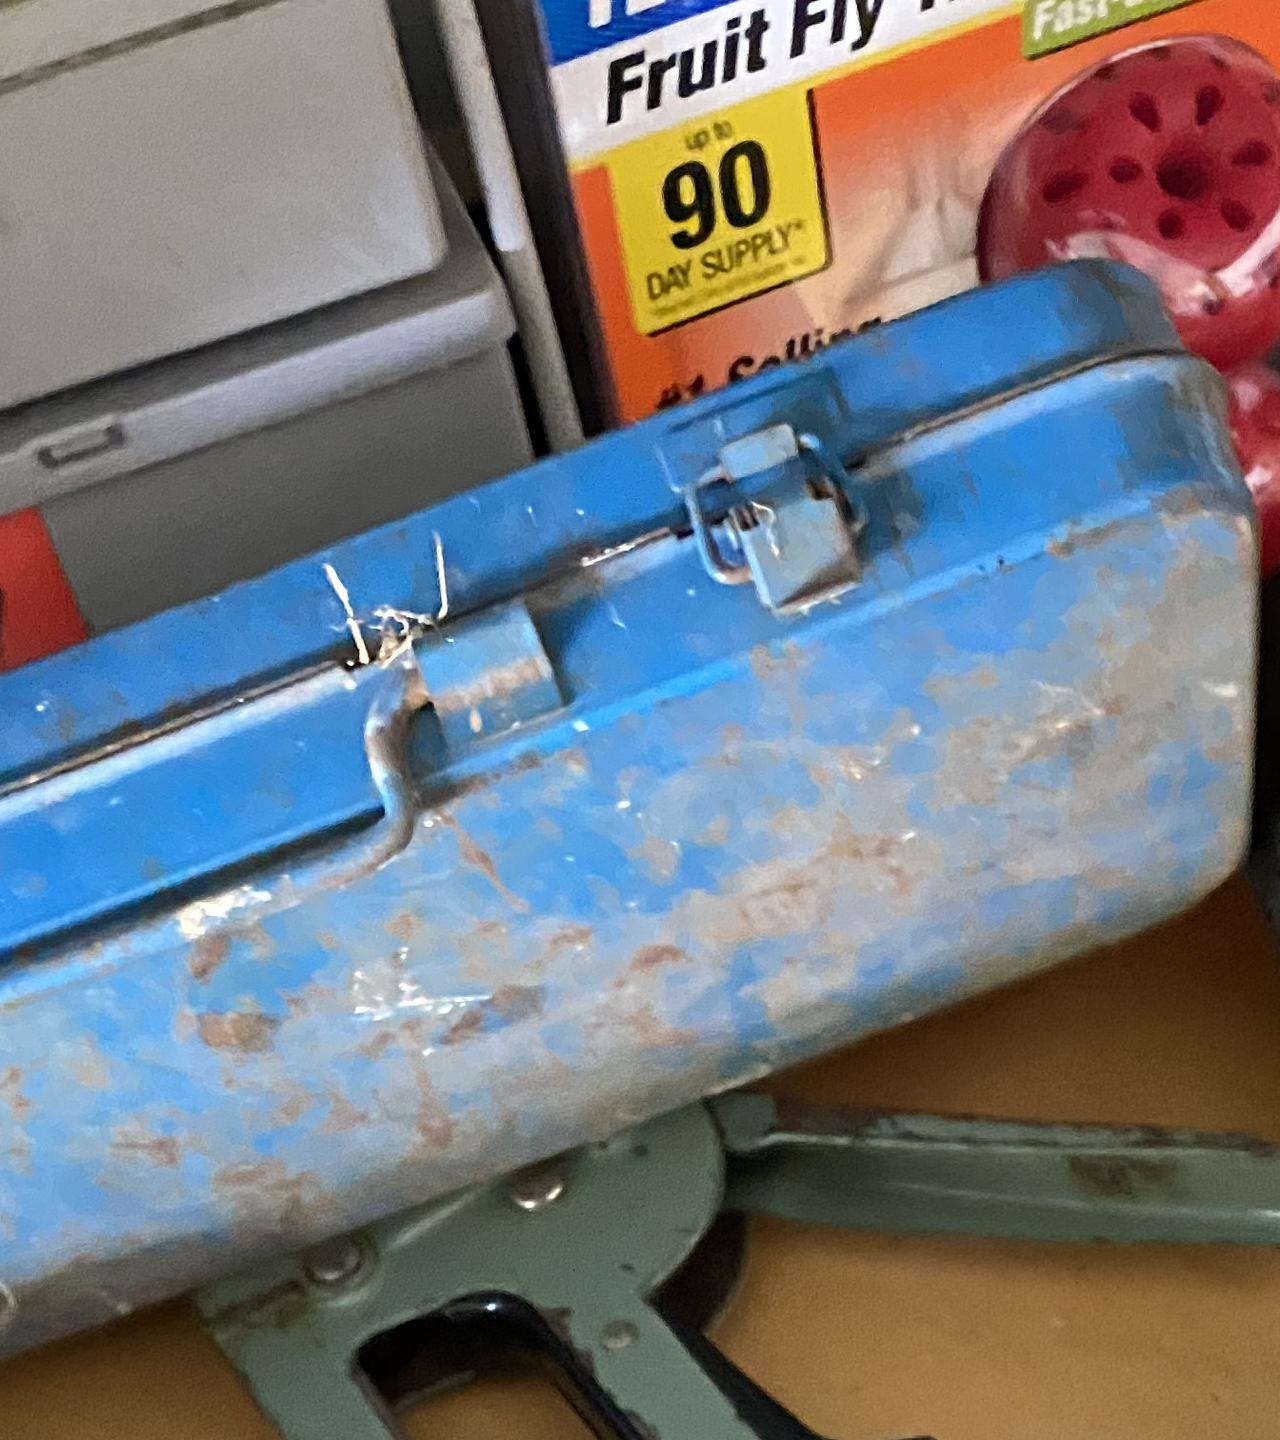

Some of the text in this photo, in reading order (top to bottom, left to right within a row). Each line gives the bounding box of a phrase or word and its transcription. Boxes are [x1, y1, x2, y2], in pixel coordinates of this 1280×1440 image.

[605, 9, 769, 125] Fruit
[661, 139, 772, 249] 90
[646, 260, 693, 301] DAY
